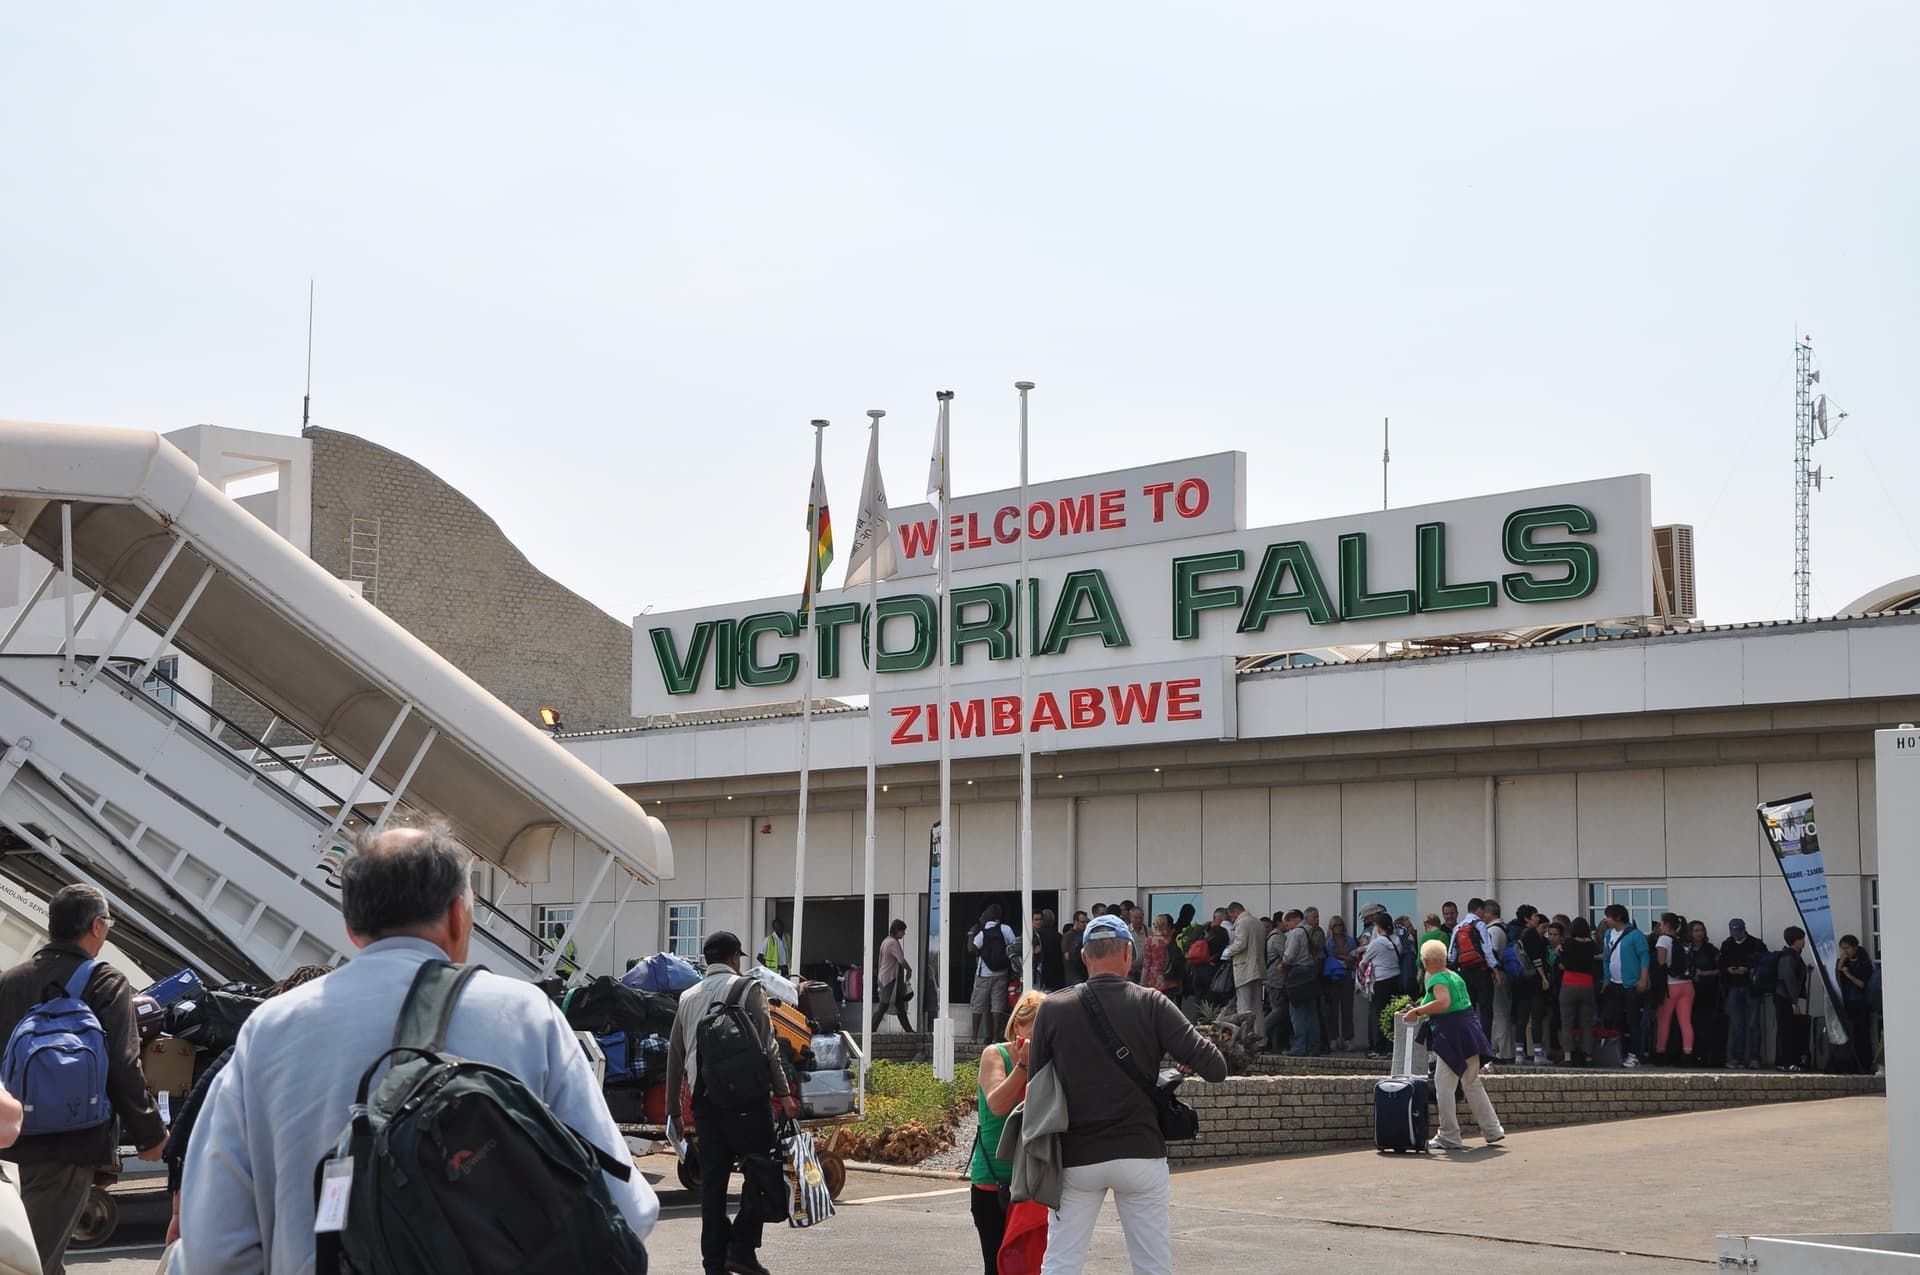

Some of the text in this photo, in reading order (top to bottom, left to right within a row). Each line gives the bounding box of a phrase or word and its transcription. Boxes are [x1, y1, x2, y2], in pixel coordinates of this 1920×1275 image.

[898, 477, 1210, 559] WELCOME TO
[648, 503, 1599, 695] VICTORIA FALLS
[890, 678, 1203, 745] ZIMBABWE
[1897, 736, 1920, 749] HO
[1769, 822, 1817, 842] UNWTO
[0, 883, 28, 905] ANDLING
